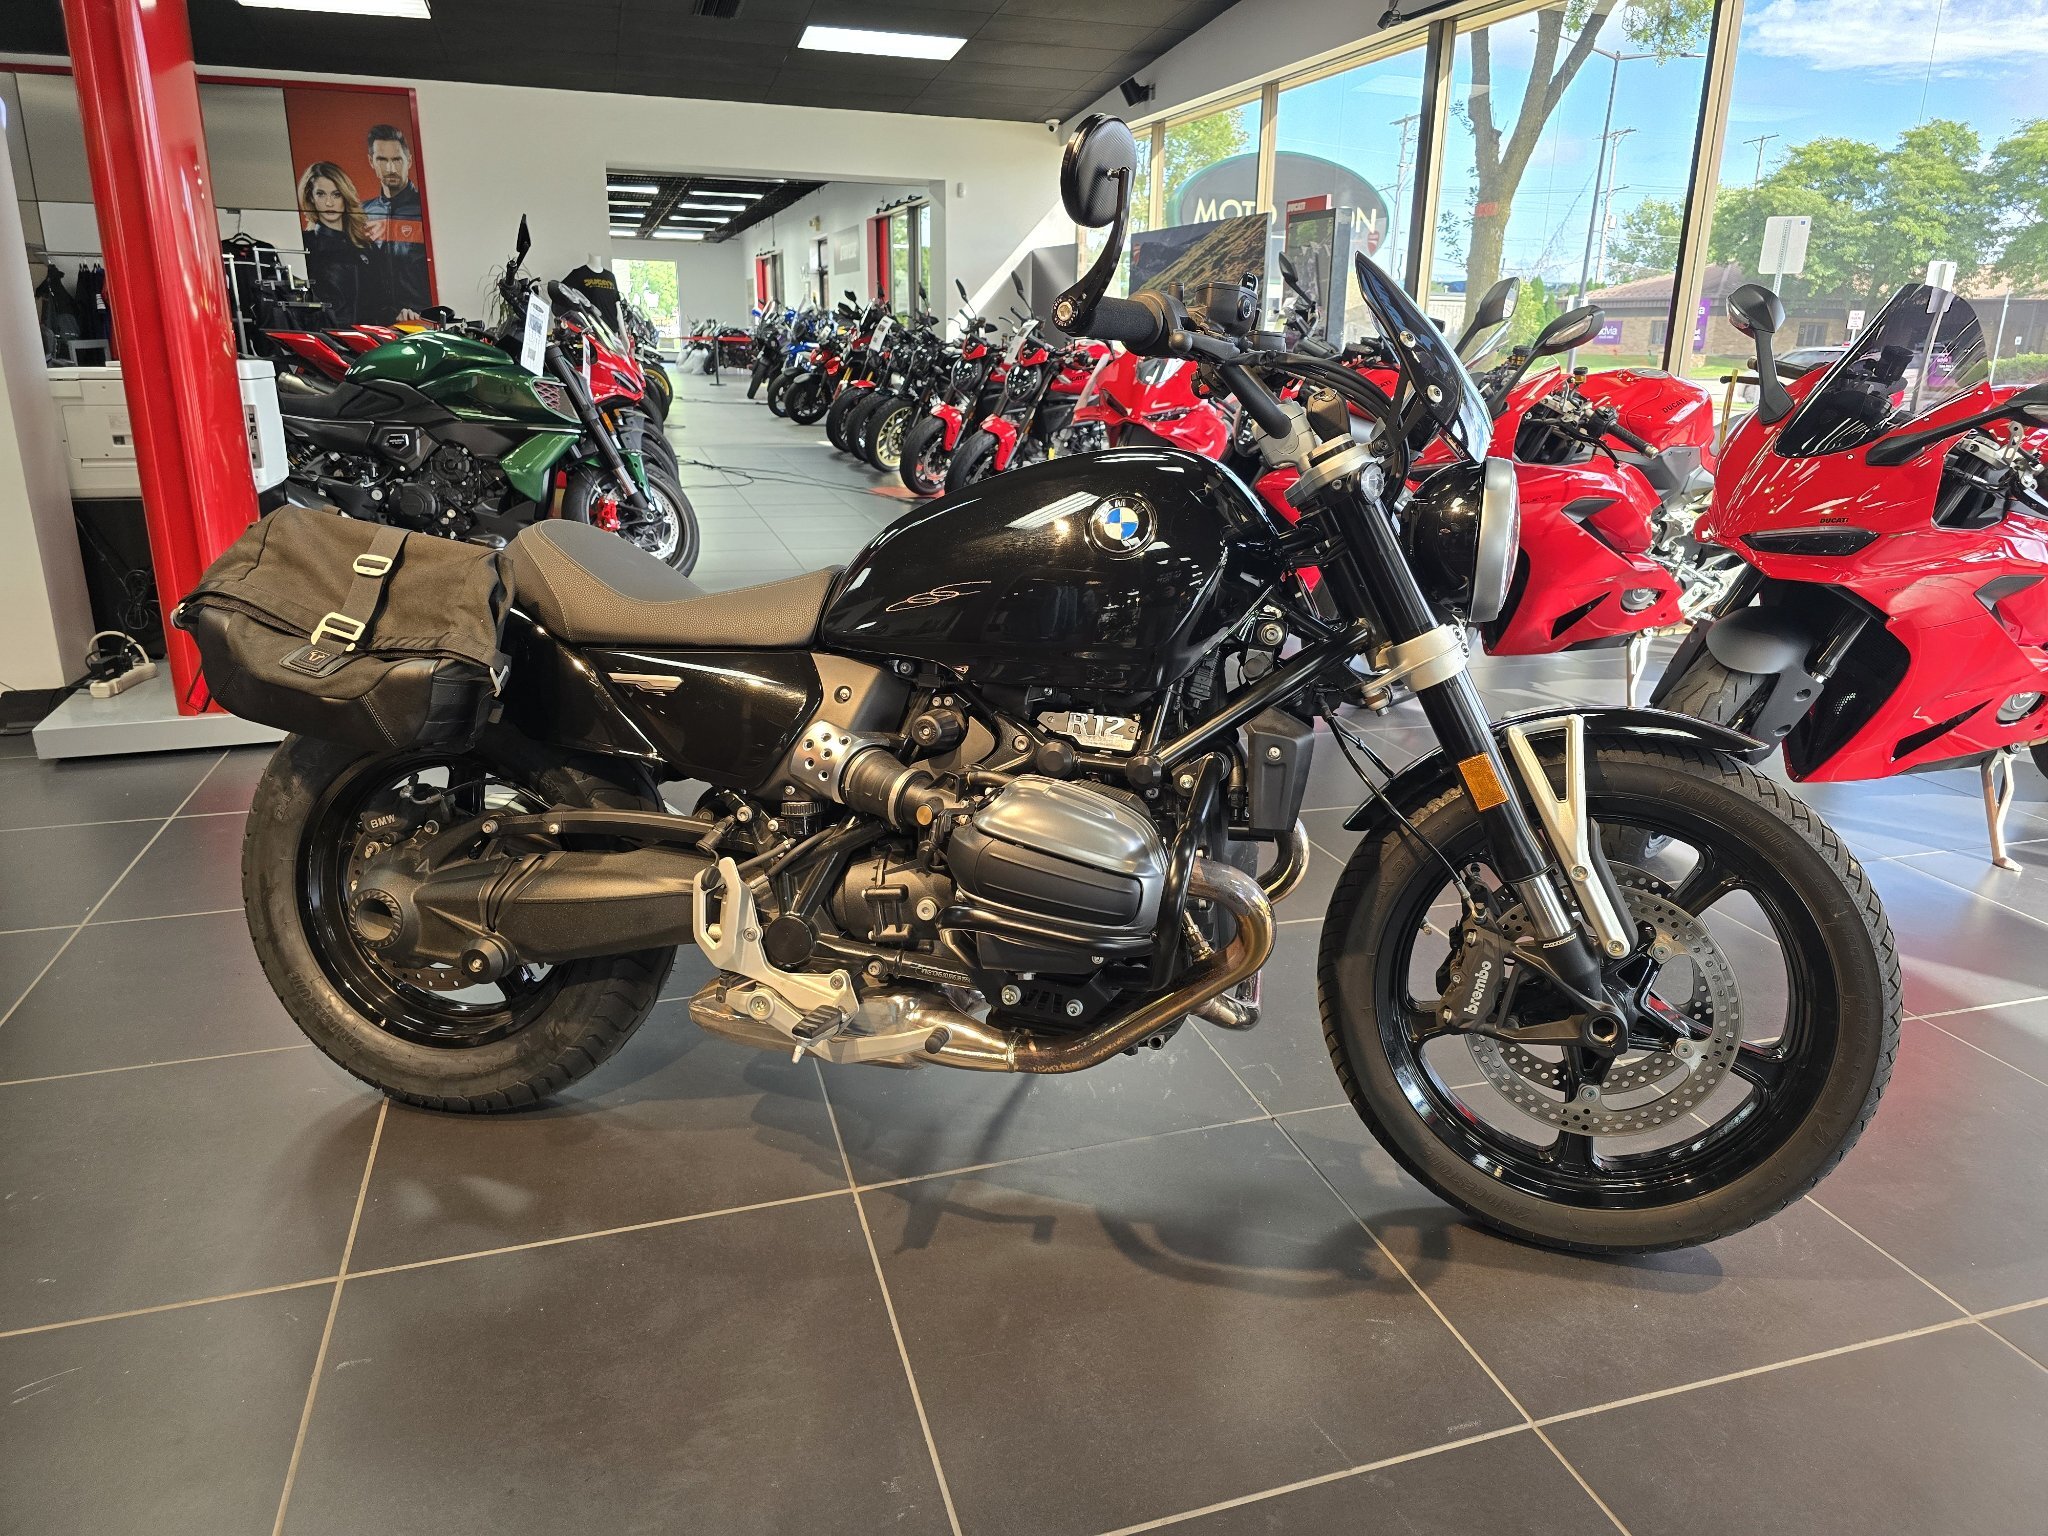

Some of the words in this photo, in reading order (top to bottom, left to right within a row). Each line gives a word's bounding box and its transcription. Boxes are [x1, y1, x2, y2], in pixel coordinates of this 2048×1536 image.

[1662, 397, 1688, 413] DUCATI
[370, 814, 396, 829] BMW
[1463, 960, 1492, 1015] brembo
